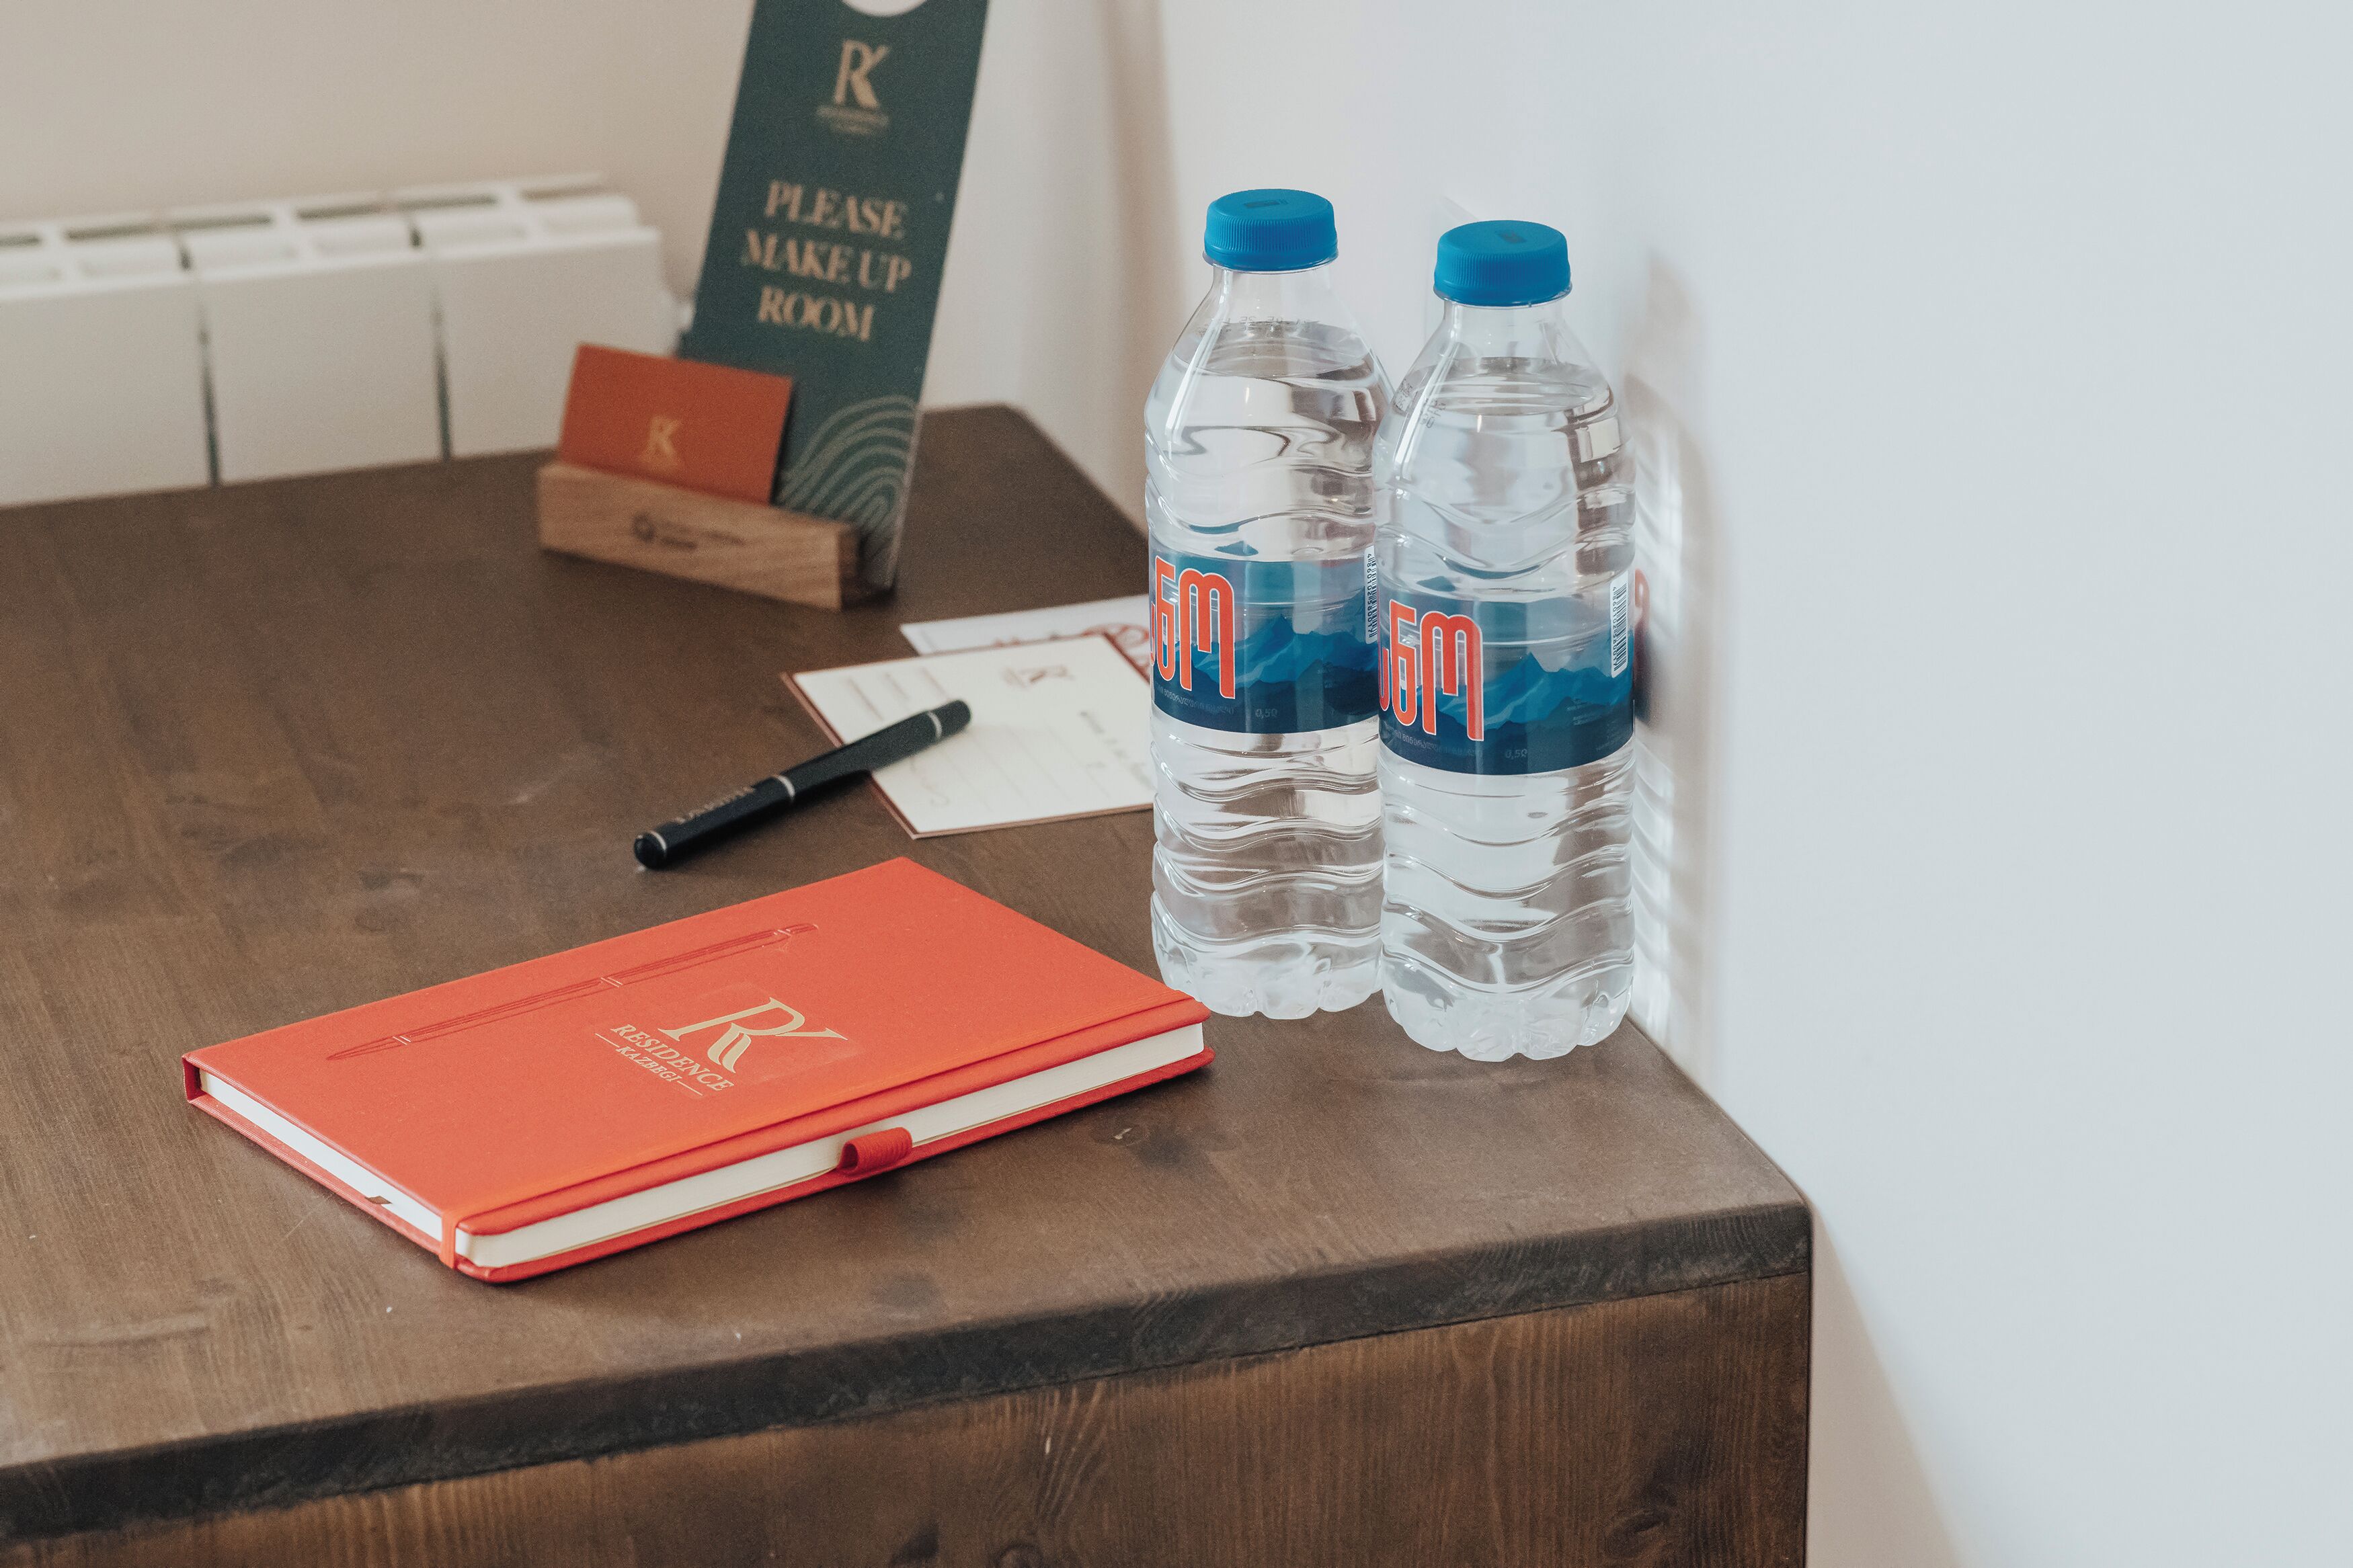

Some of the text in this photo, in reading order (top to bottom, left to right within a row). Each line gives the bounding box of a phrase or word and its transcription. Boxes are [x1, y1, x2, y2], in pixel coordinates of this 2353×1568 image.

[765, 179, 909, 239] PLEASE
[742, 229, 912, 293] MAKE UP
[758, 285, 876, 341] ROOM
[610, 1024, 735, 1091] RESIDENCE
[615, 1046, 682, 1082] KAZBEGI
